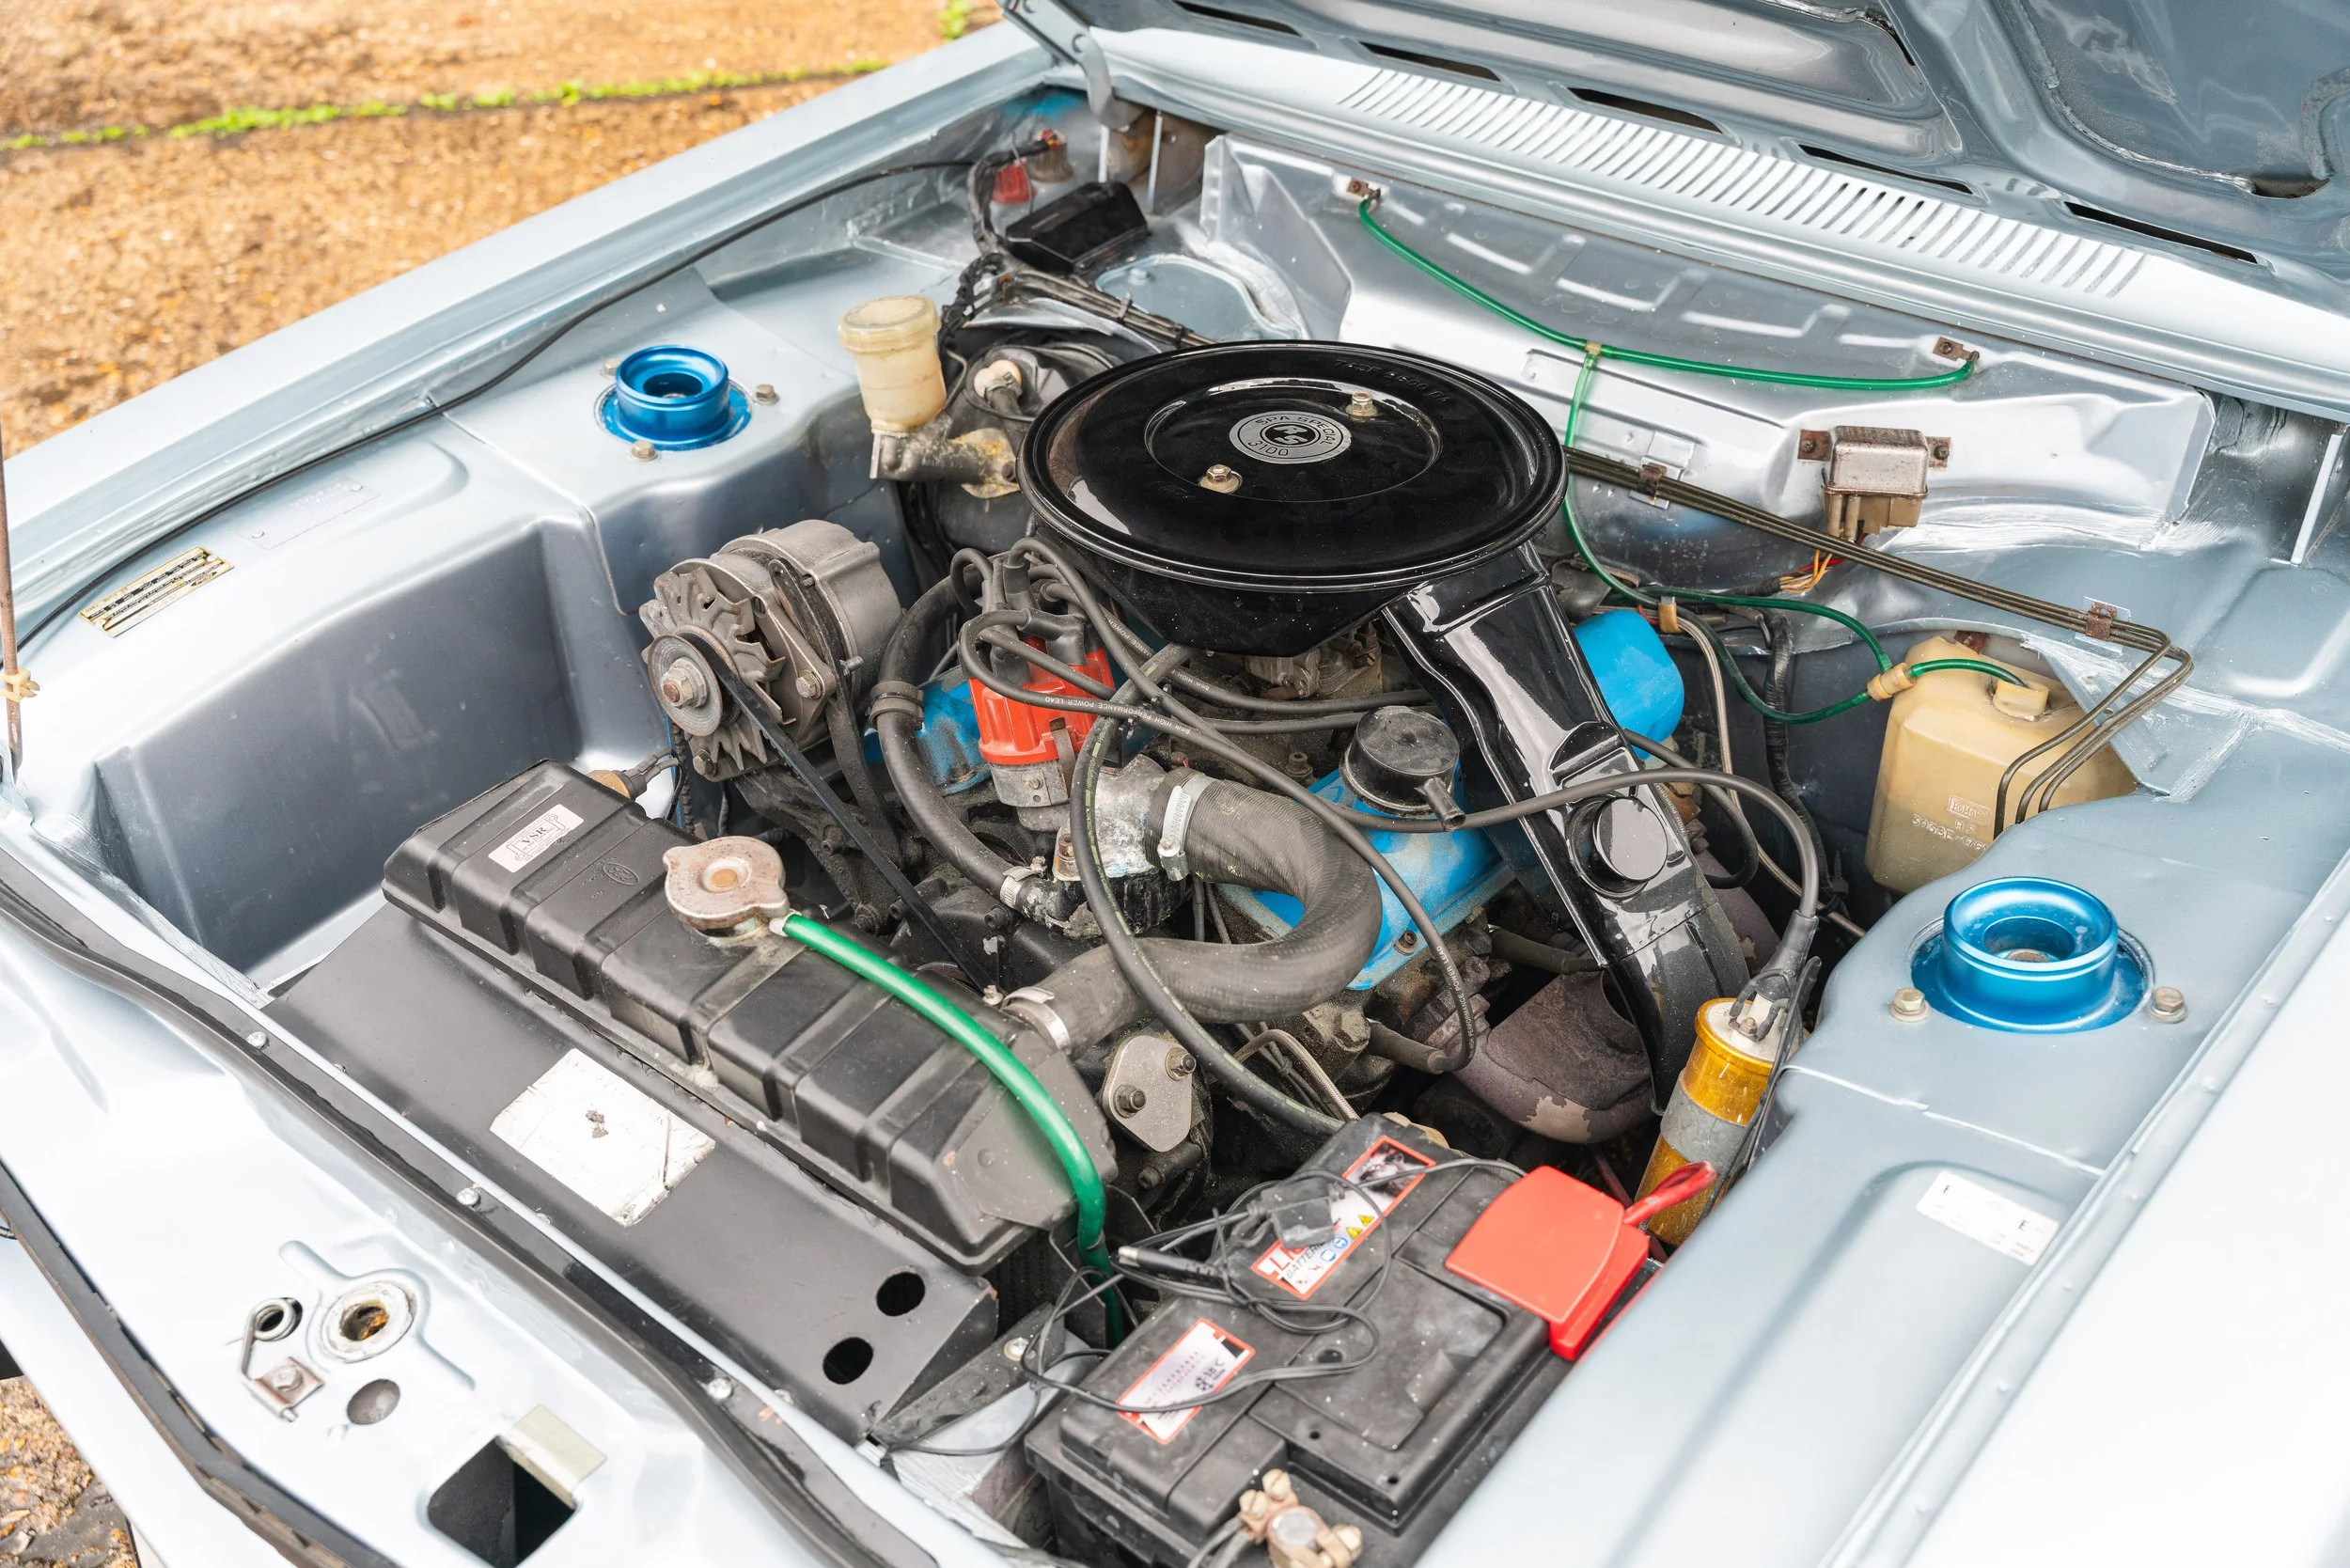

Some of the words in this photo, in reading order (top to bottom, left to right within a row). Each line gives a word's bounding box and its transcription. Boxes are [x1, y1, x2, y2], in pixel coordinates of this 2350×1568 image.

[1255, 416, 1291, 426] SPA
[1297, 416, 1333, 446] SPECIAL
[1248, 440, 1289, 457] 3100
[1108, 619, 1130, 639] POWER
[1177, 672, 1194, 683] HIGH
[1044, 696, 1064, 705] LEAD
[1067, 699, 1094, 708] POWER
[1098, 702, 1152, 721] PERFORMANCE
[1154, 717, 1172, 728] HIGH
[521, 824, 548, 845] VSR
[1436, 945, 1449, 964] LEAD
[1447, 966, 1461, 992] POWER
[1458, 993, 1474, 1036] PERFORMANCE
